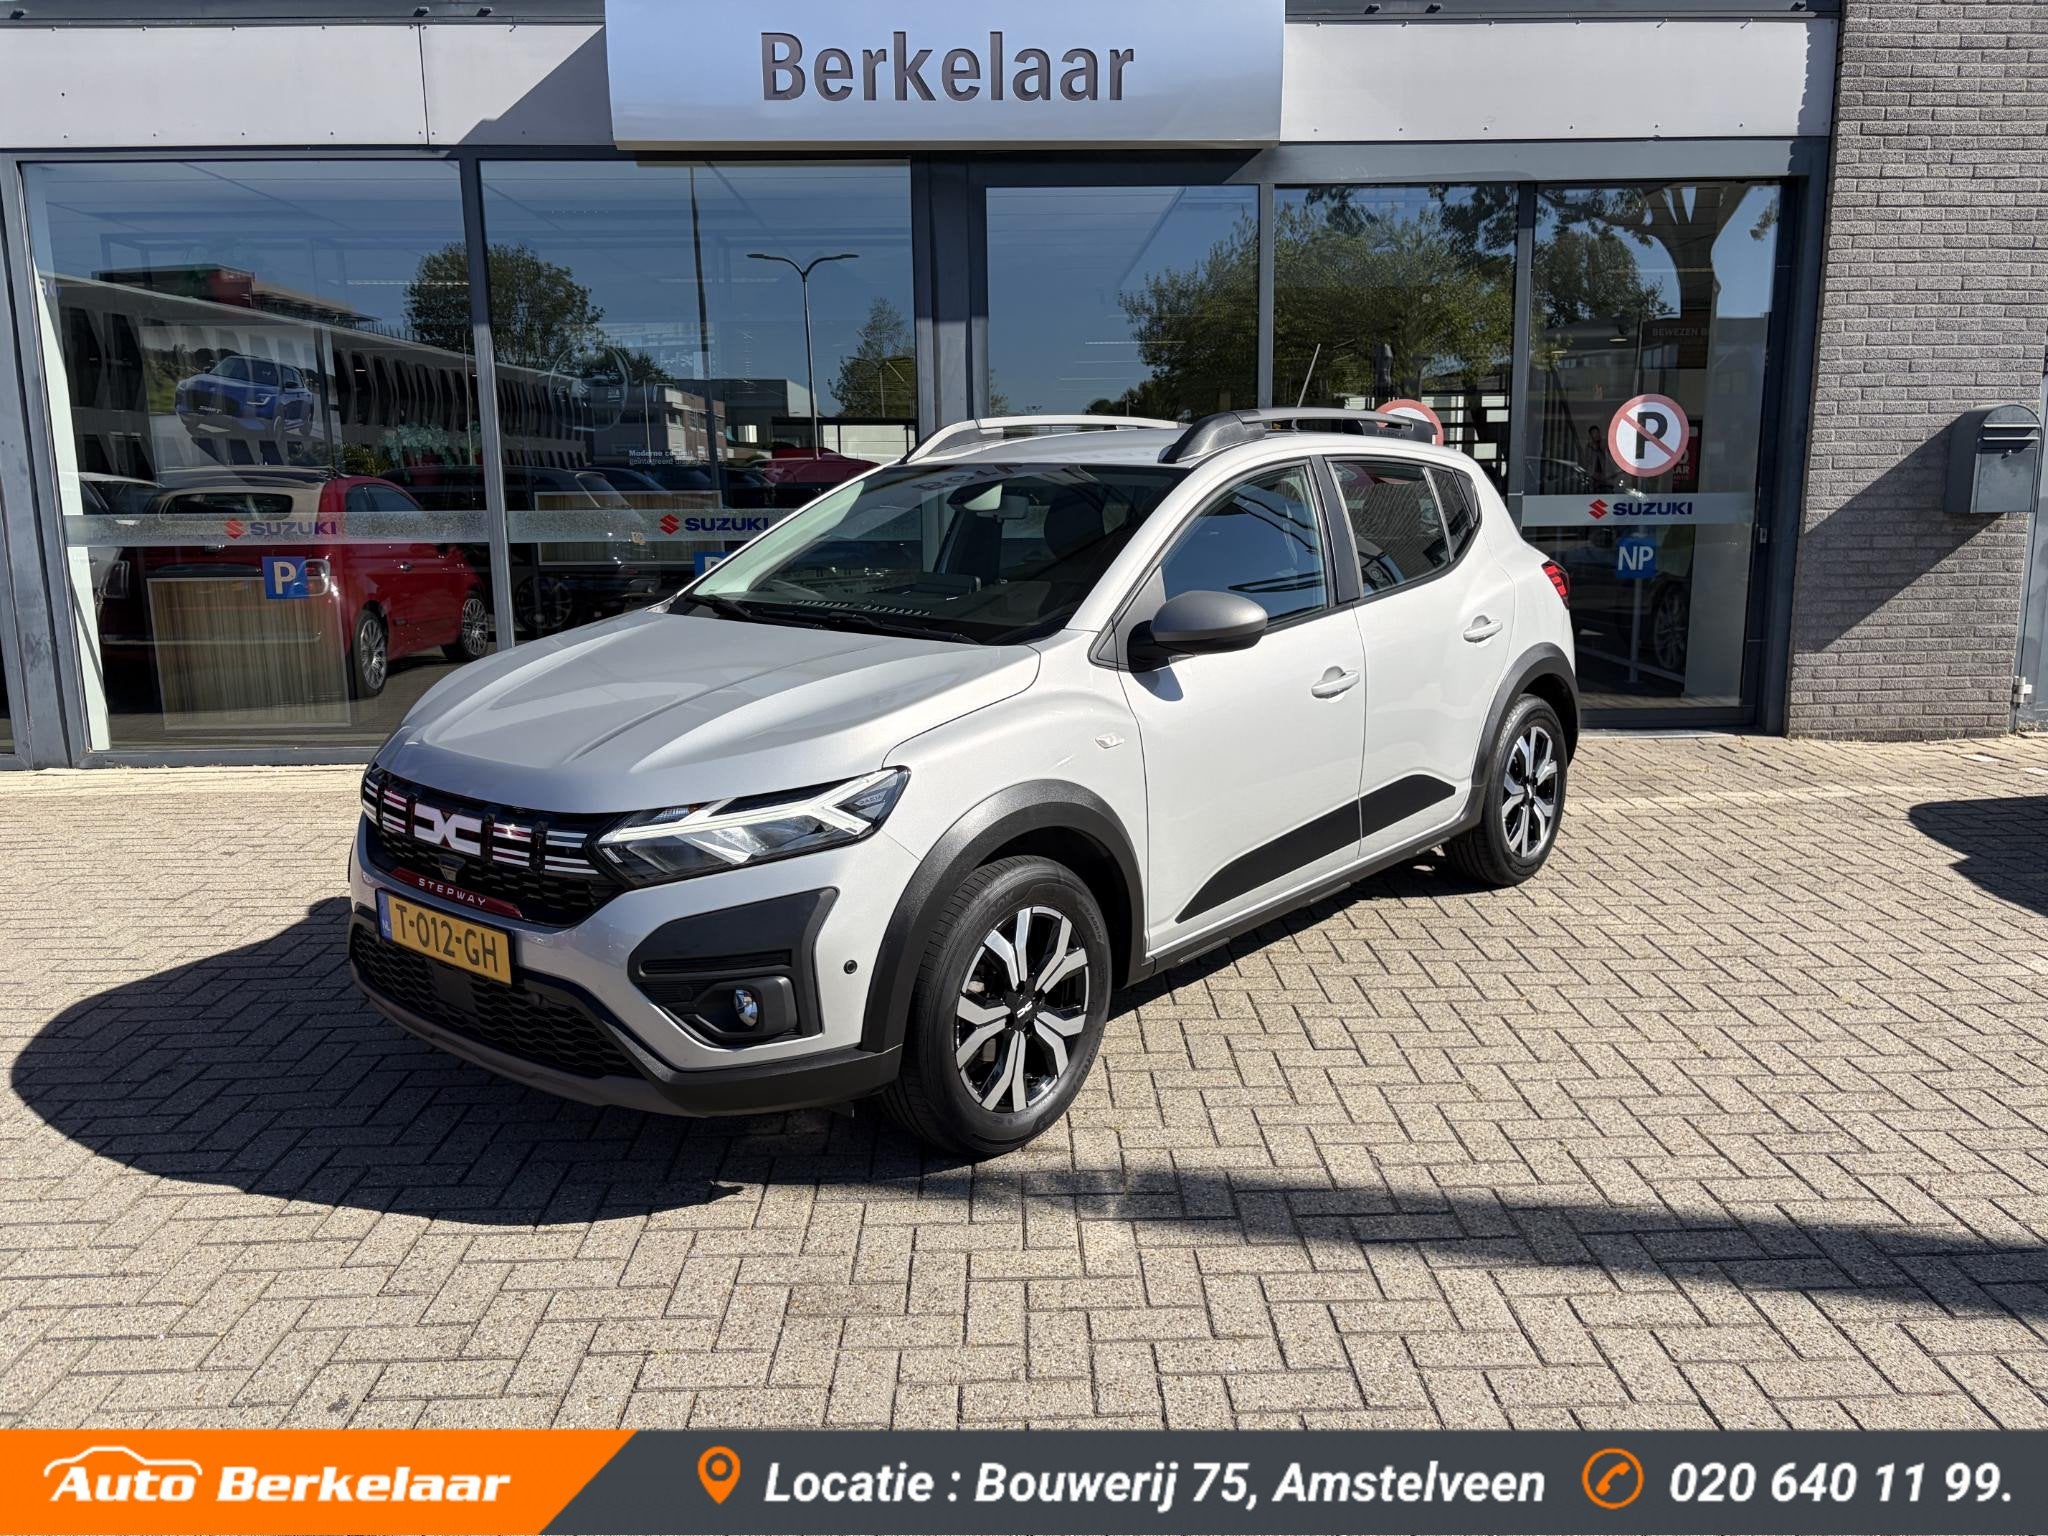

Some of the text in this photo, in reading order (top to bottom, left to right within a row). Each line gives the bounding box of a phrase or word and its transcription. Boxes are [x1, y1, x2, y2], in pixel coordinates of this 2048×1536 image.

[761, 31, 1134, 101] Berkelaar
[1635, 411, 1668, 459] P
[1612, 502, 1693, 516] SUZUKI
[250, 522, 336, 535] SUZUKI
[685, 517, 769, 531] SUZUKI
[1617, 545, 1654, 571] NP
[273, 561, 297, 595] P
[418, 878, 486, 906] STEPWAY
[395, 903, 498, 974] T-012-GH
